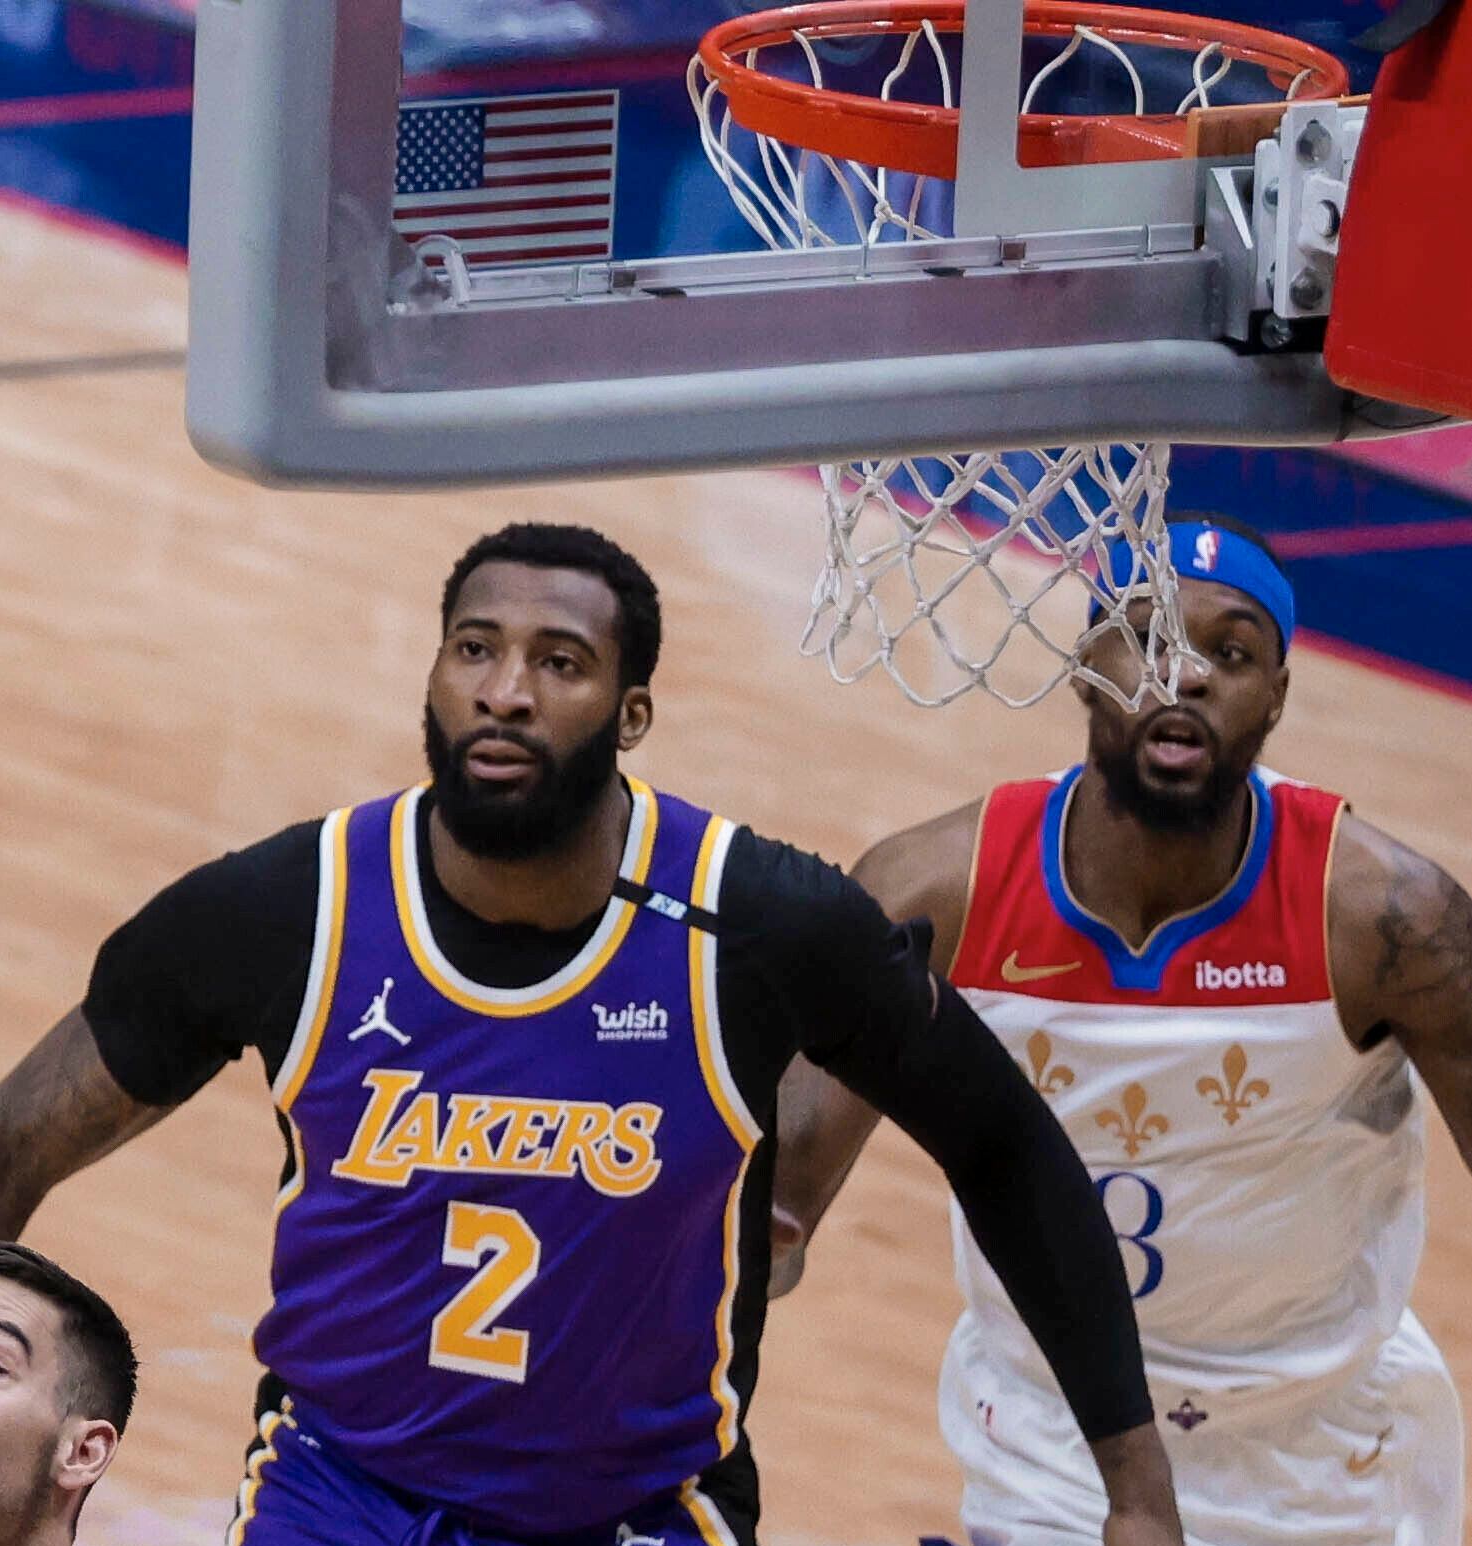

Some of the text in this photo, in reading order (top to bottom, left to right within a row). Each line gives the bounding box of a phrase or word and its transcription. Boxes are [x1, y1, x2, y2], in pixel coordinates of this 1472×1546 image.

[591, 1000, 668, 1029] wish
[1194, 959, 1287, 991] ibotta
[332, 1068, 662, 1198] LAKERS
[428, 1201, 541, 1384] 2
